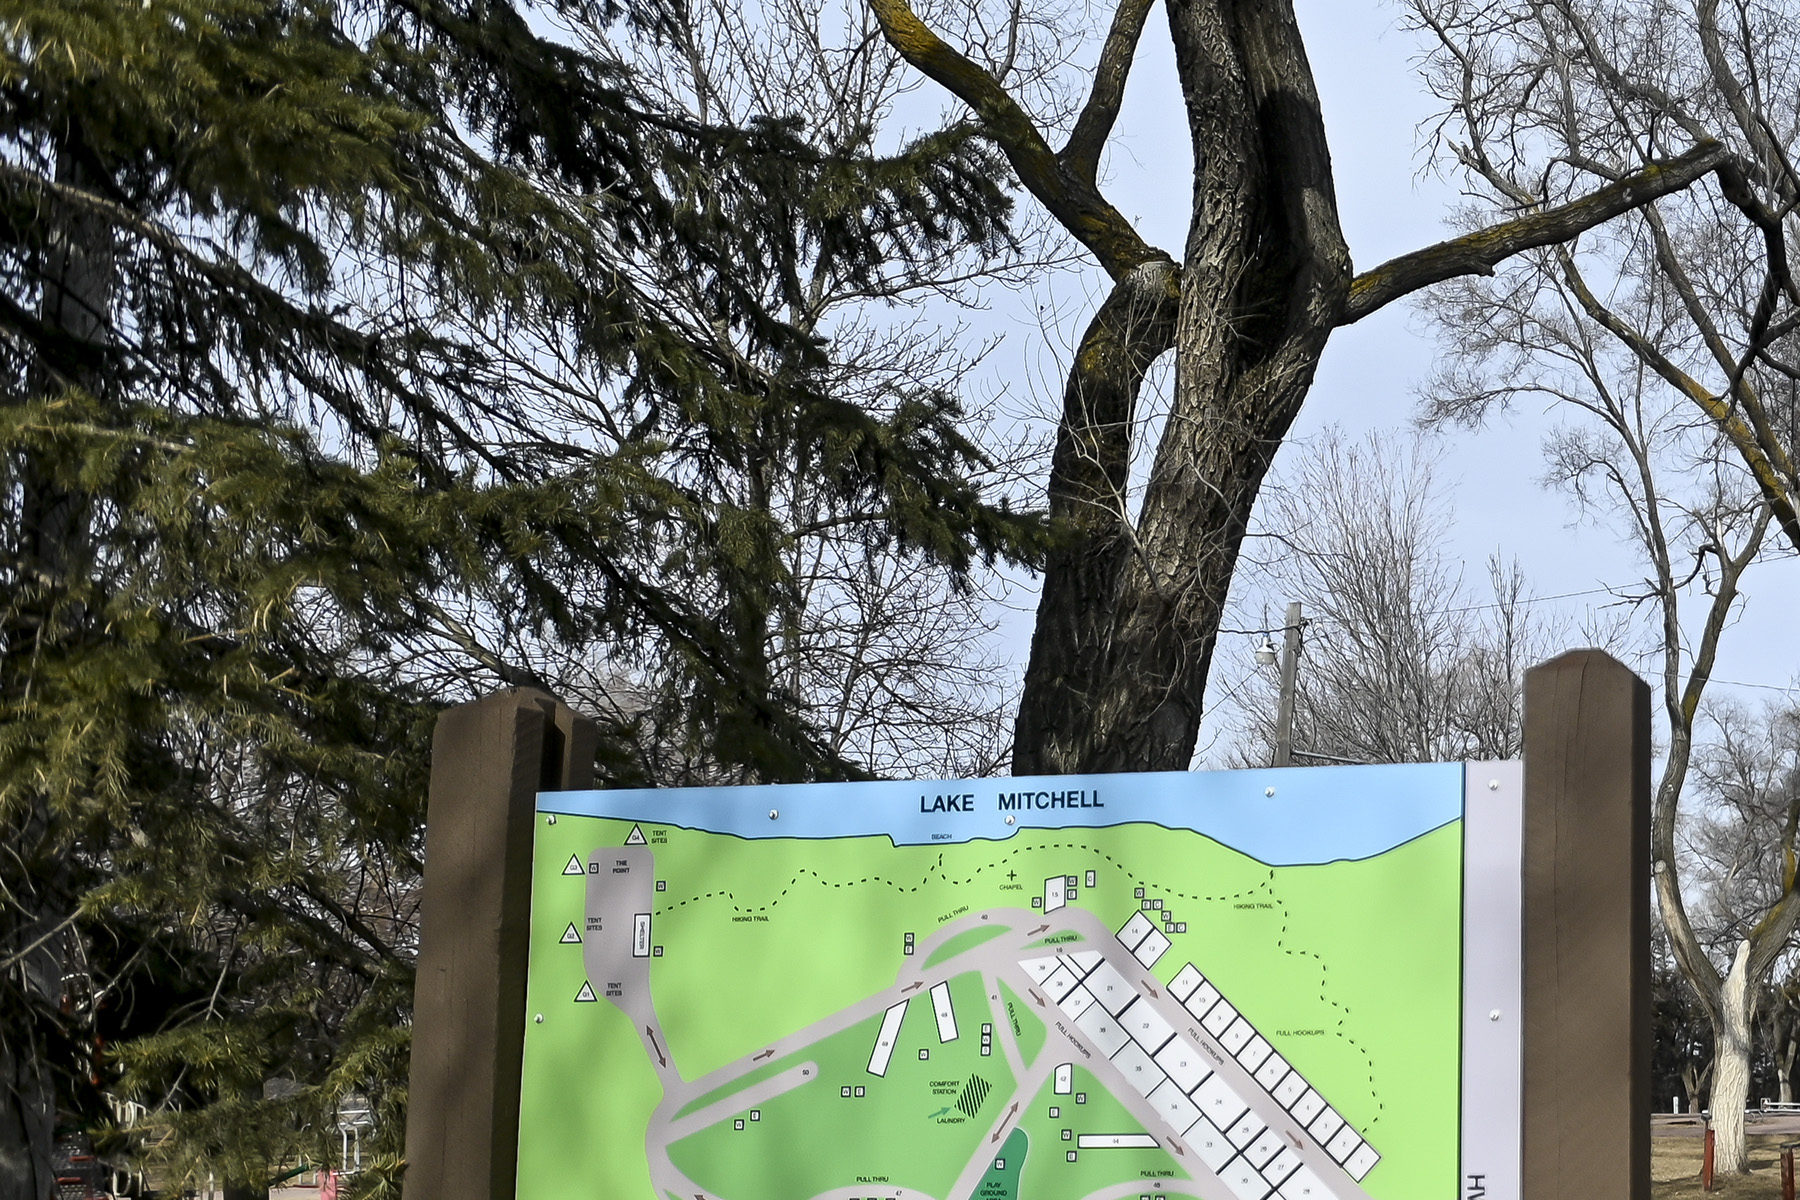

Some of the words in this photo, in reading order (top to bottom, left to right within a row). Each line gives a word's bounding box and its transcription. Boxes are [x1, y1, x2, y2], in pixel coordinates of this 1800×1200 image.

[920, 794, 974, 813] LAKE
[998, 790, 1104, 810] MITCHELL
[929, 1080, 960, 1088] COMFORT
